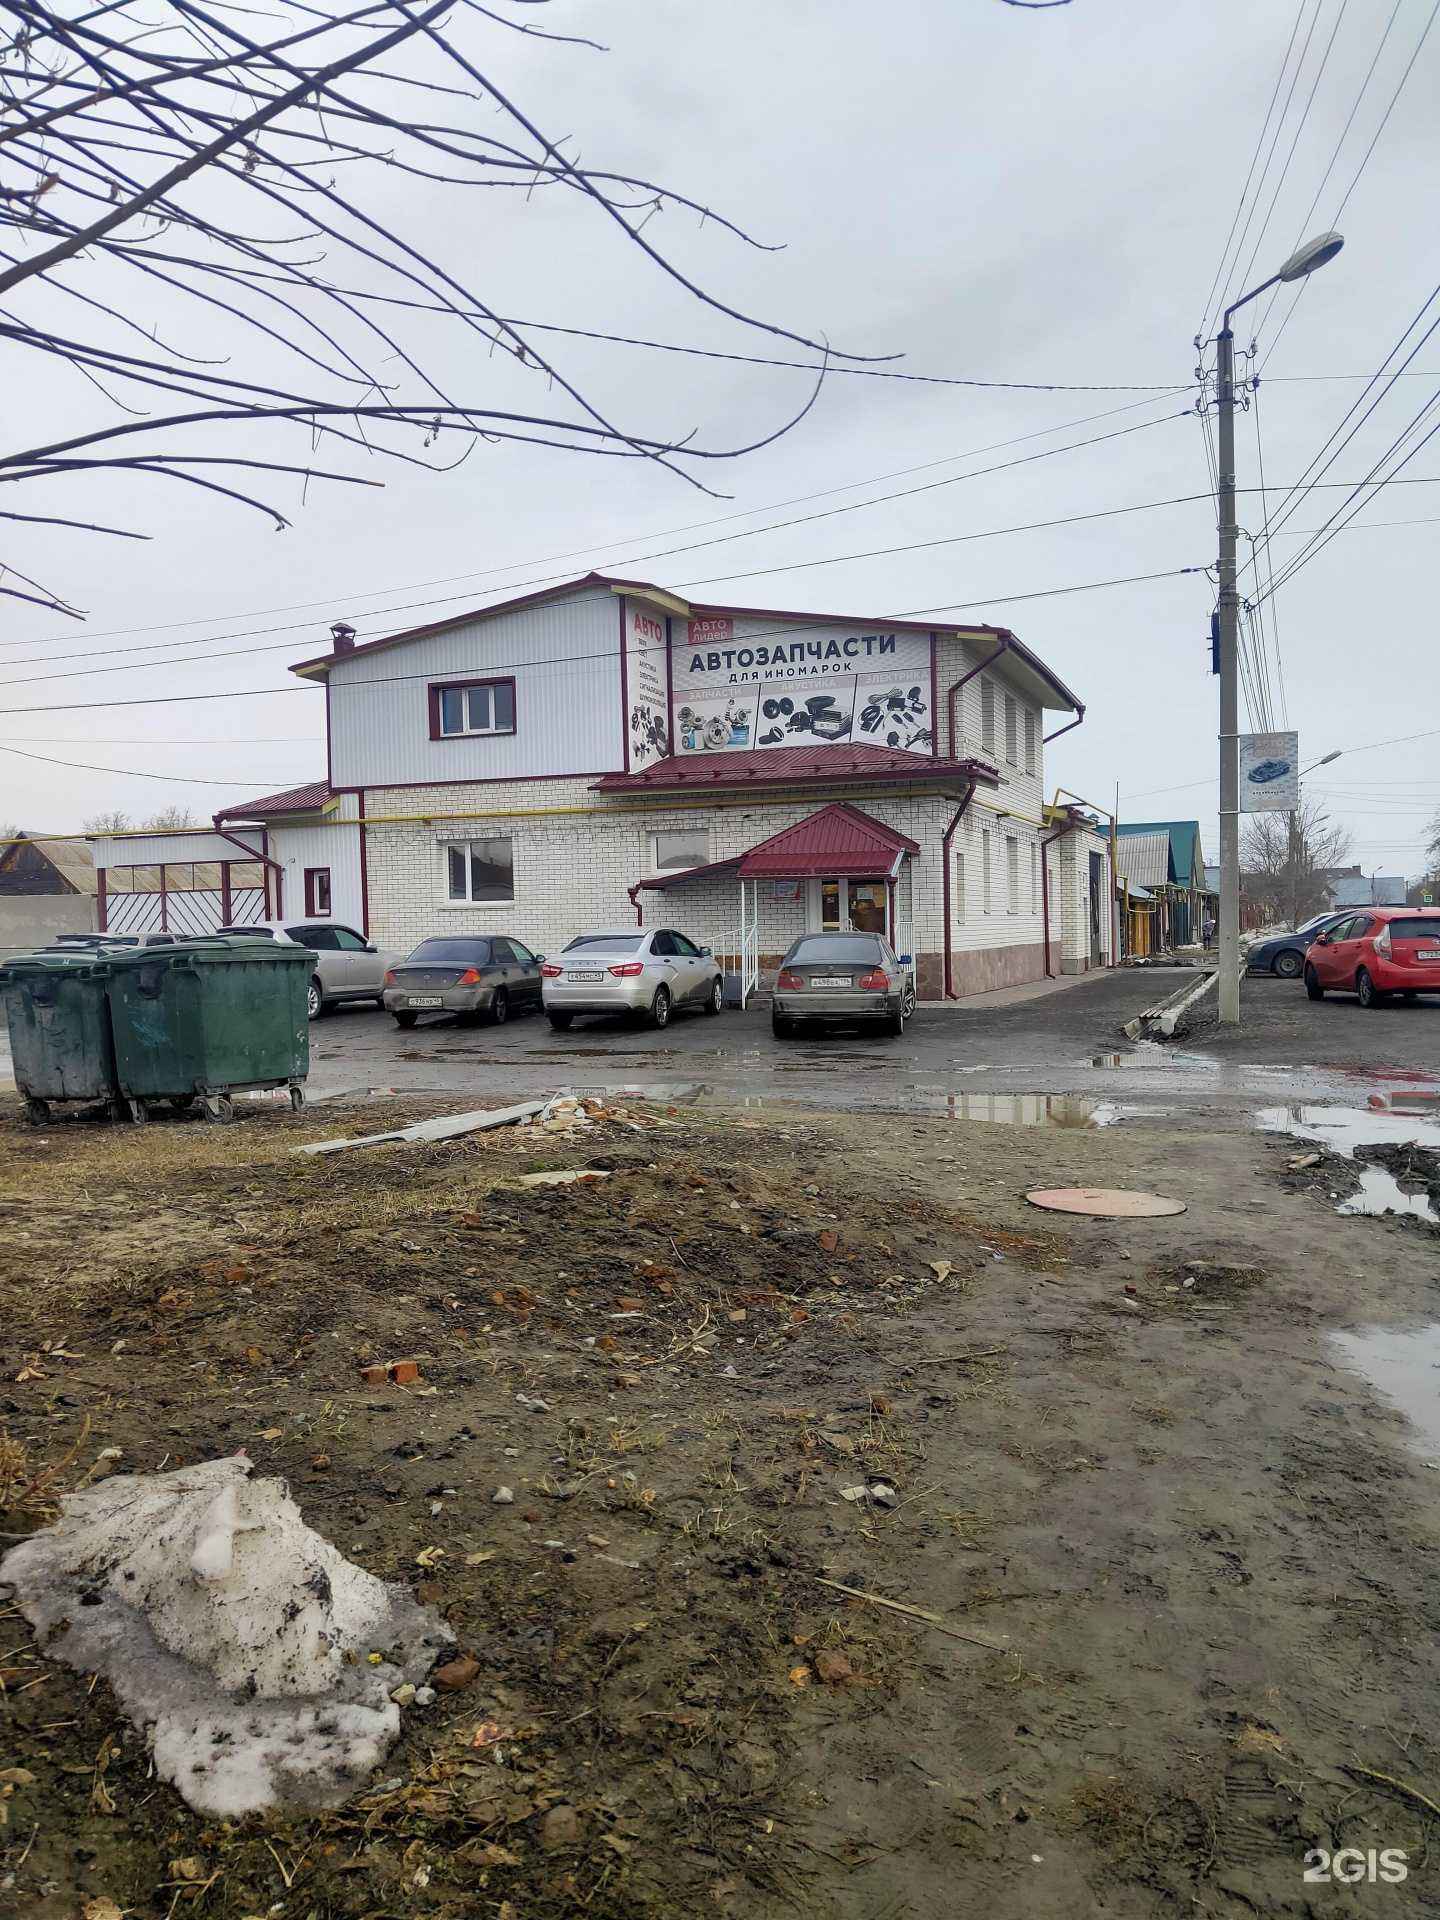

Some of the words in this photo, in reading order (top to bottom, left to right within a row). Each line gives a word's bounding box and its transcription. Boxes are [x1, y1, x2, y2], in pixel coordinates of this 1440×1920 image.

[634, 613, 663, 642] АВТО
[692, 619, 727, 632] АВТО
[692, 632, 727, 643] лидер
[689, 634, 896, 673] АВТОЗАПЧАСТИ
[728, 671, 759, 684] ДЛЯ
[764, 661, 853, 680] ИНОМАРОК
[865, 671, 930, 685] ЭЛЕКТРИКА
[780, 680, 838, 692] АКУСТИКА
[688, 688, 743, 701] ЗАПЧАСТИ
